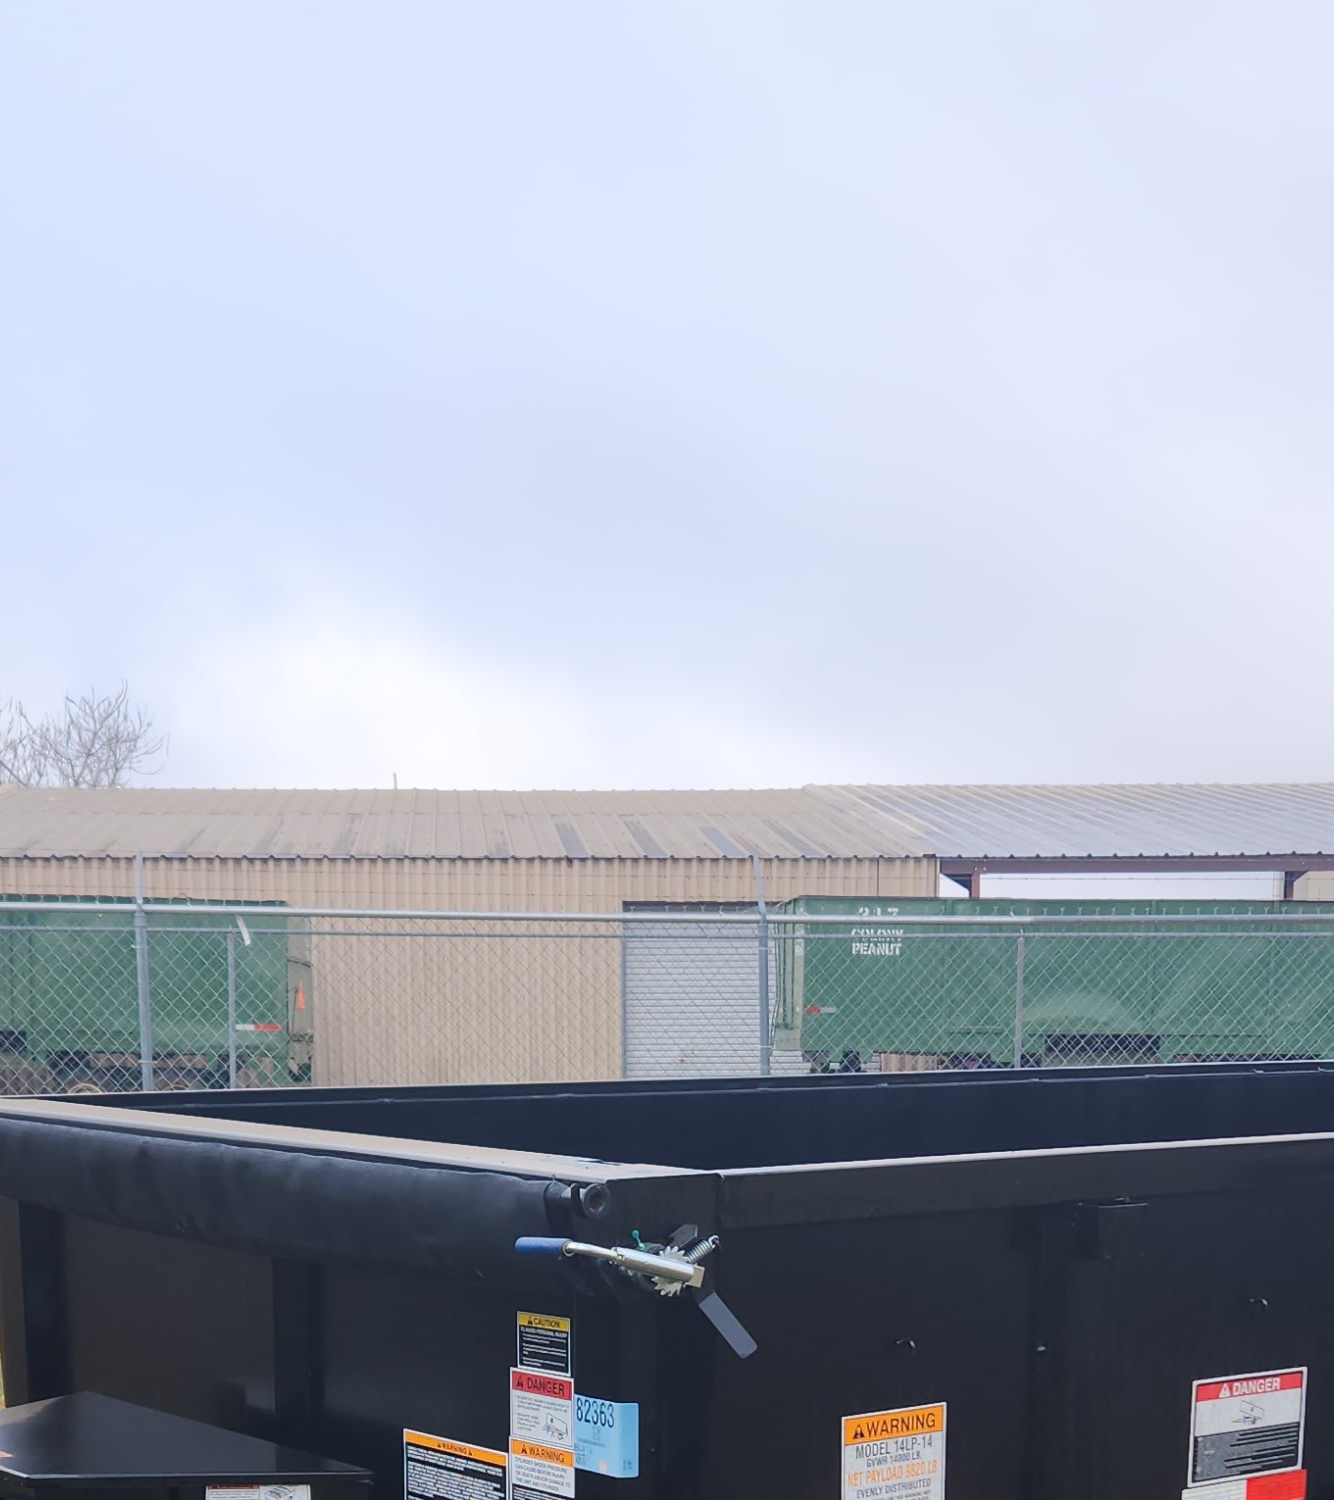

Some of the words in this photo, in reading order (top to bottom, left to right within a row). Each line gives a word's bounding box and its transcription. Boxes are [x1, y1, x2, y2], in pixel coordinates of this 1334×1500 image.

[851, 942, 902, 955] PEANUT
[533, 1317, 560, 1328] CAUTION
[527, 1377, 565, 1397] DANGER
[1232, 1377, 1281, 1396] DANGER
[576, 1397, 615, 1428] 82363
[866, 1413, 936, 1438] WARNING
[528, 1445, 565, 1463] WARNING
[856, 1442, 891, 1459] MODEL
[894, 1435, 933, 1453] 14LP-14
[866, 1456, 888, 1468] GVWR
[848, 1472, 864, 1488] NET
[866, 1465, 903, 1484] PAYLOAD
[856, 1486, 884, 1499] EVENLY
[885, 1478, 932, 1494] DISTRIBUTED
